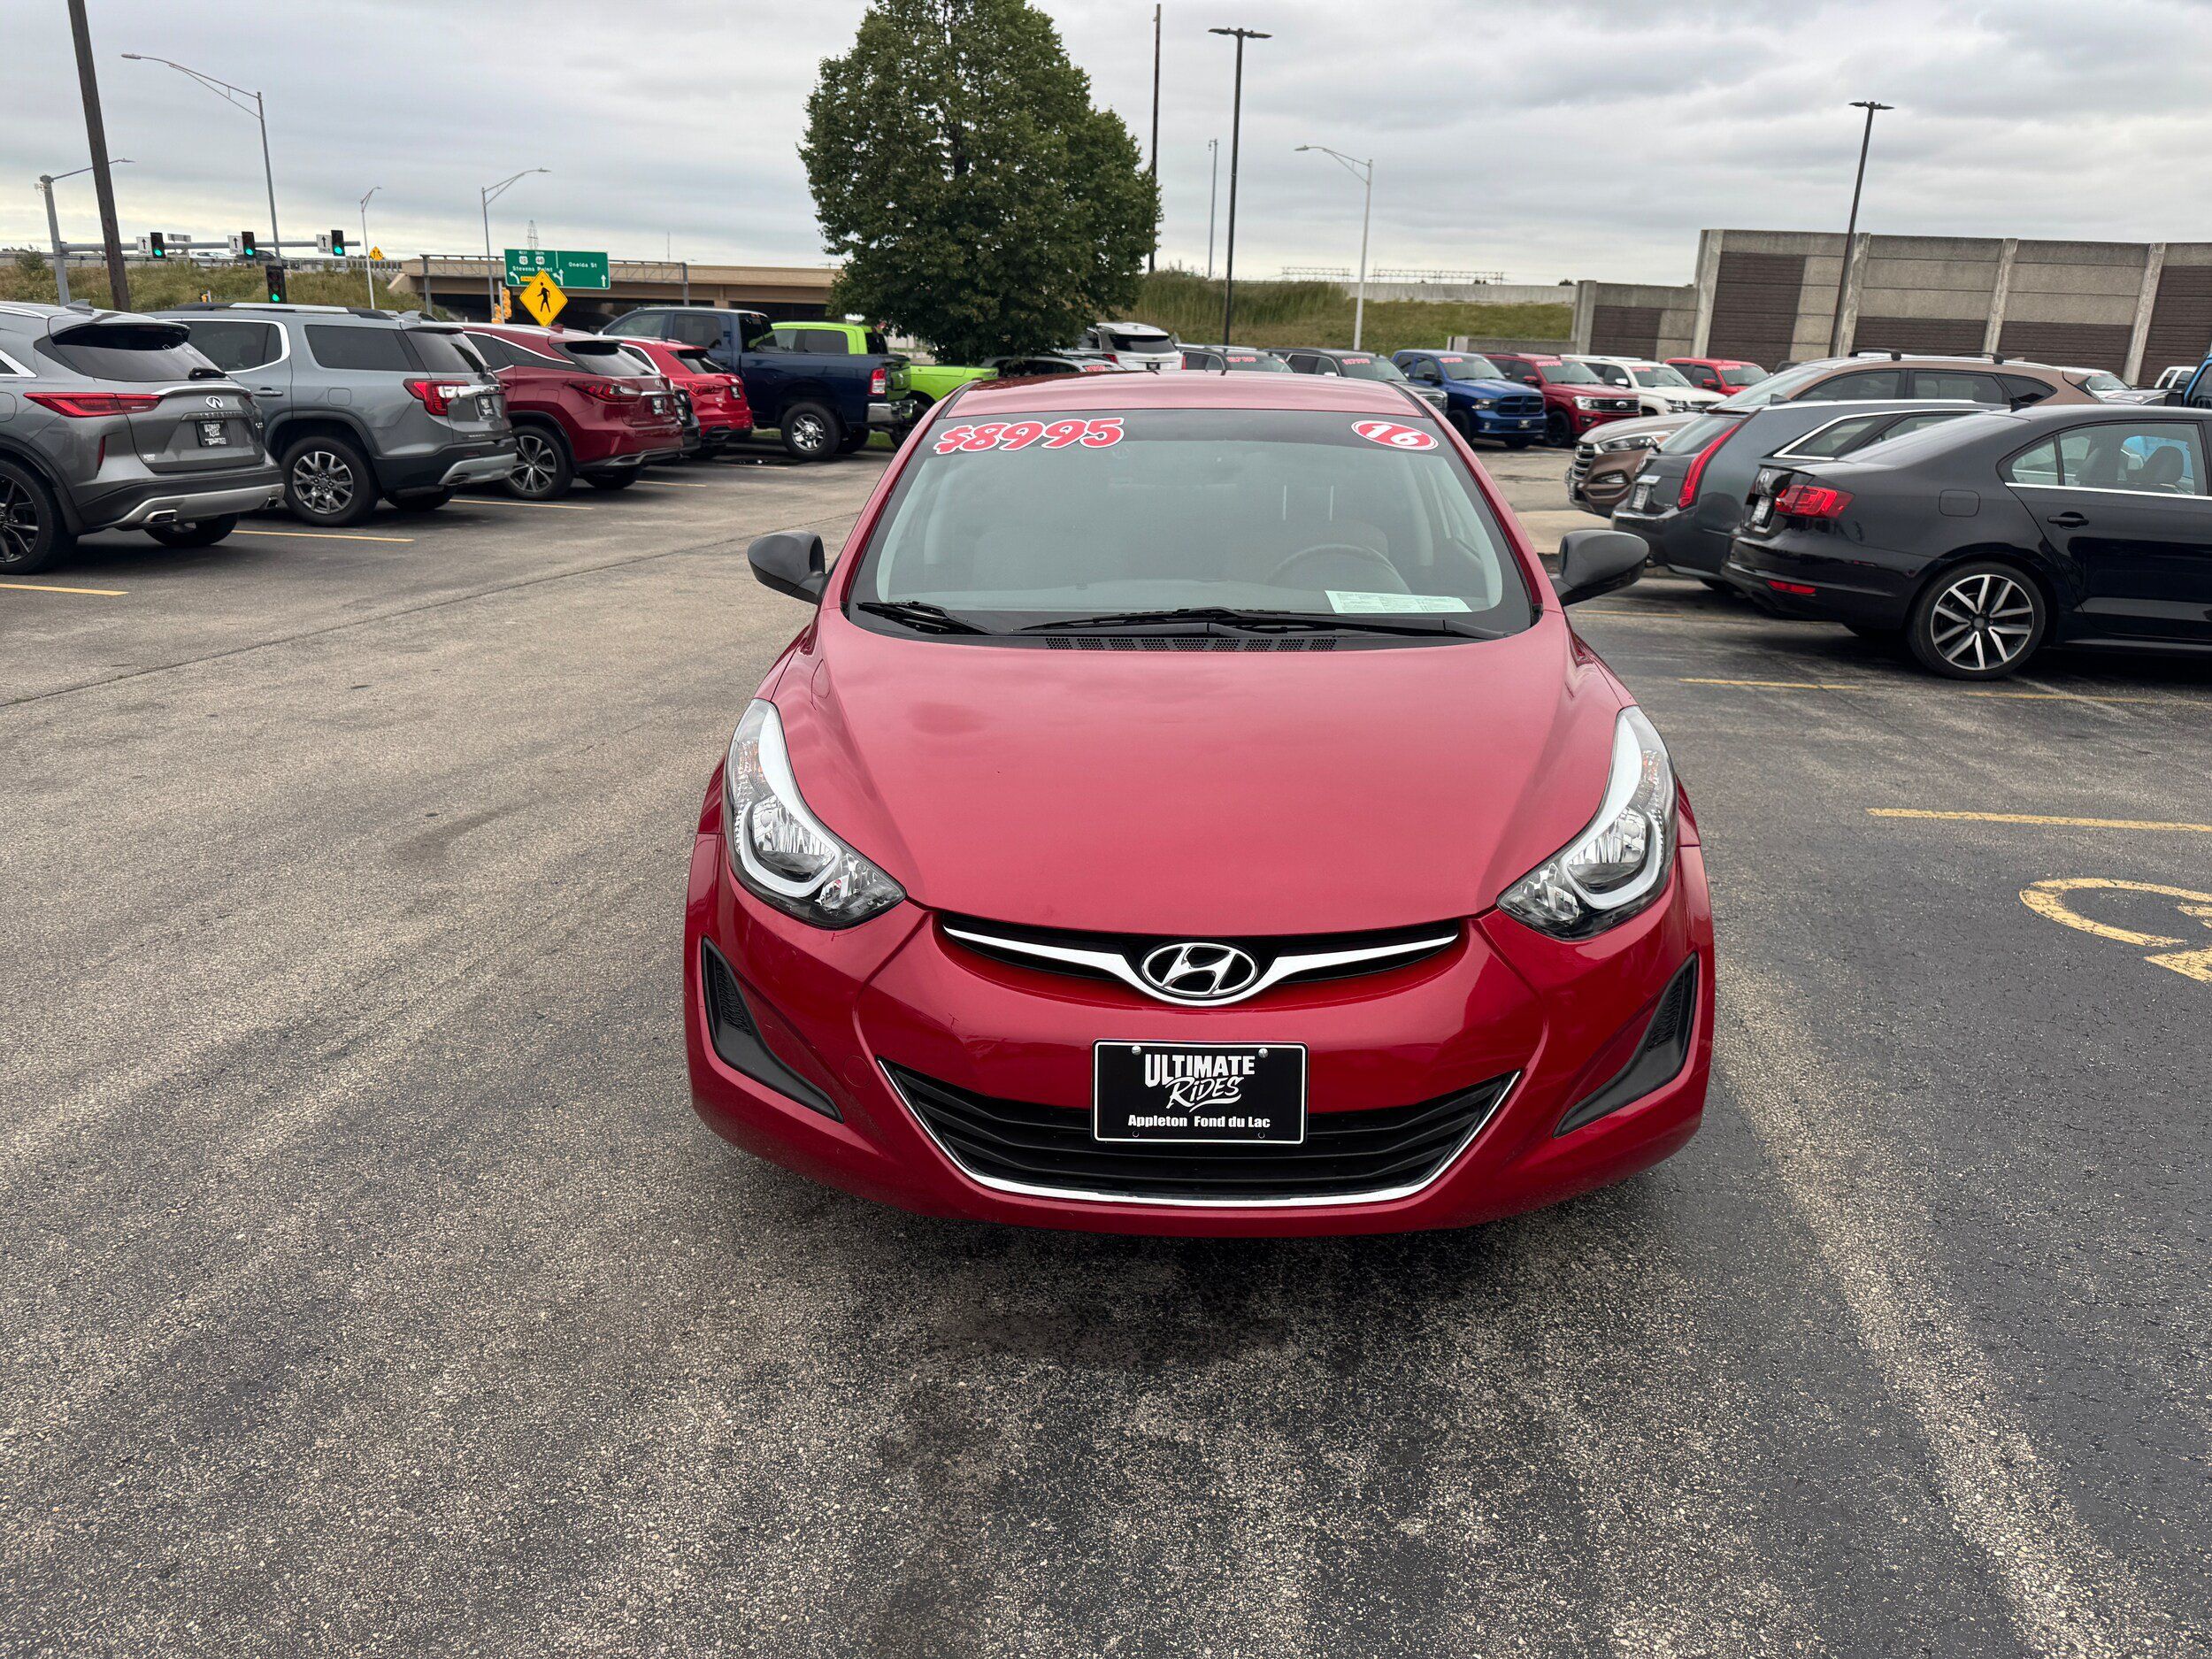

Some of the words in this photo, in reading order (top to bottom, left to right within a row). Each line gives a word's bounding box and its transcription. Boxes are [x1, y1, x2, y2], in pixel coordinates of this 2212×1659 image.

[933, 418, 1124, 454] $8995
[1365, 425, 1422, 446] 16
[1144, 1054, 1256, 1087] ULTIMATE
[1127, 1114, 1187, 1127] Appleton
[1194, 1116, 1225, 1127] Fond
[1228, 1116, 1245, 1127] du
[1248, 1117, 1271, 1128] Lac
